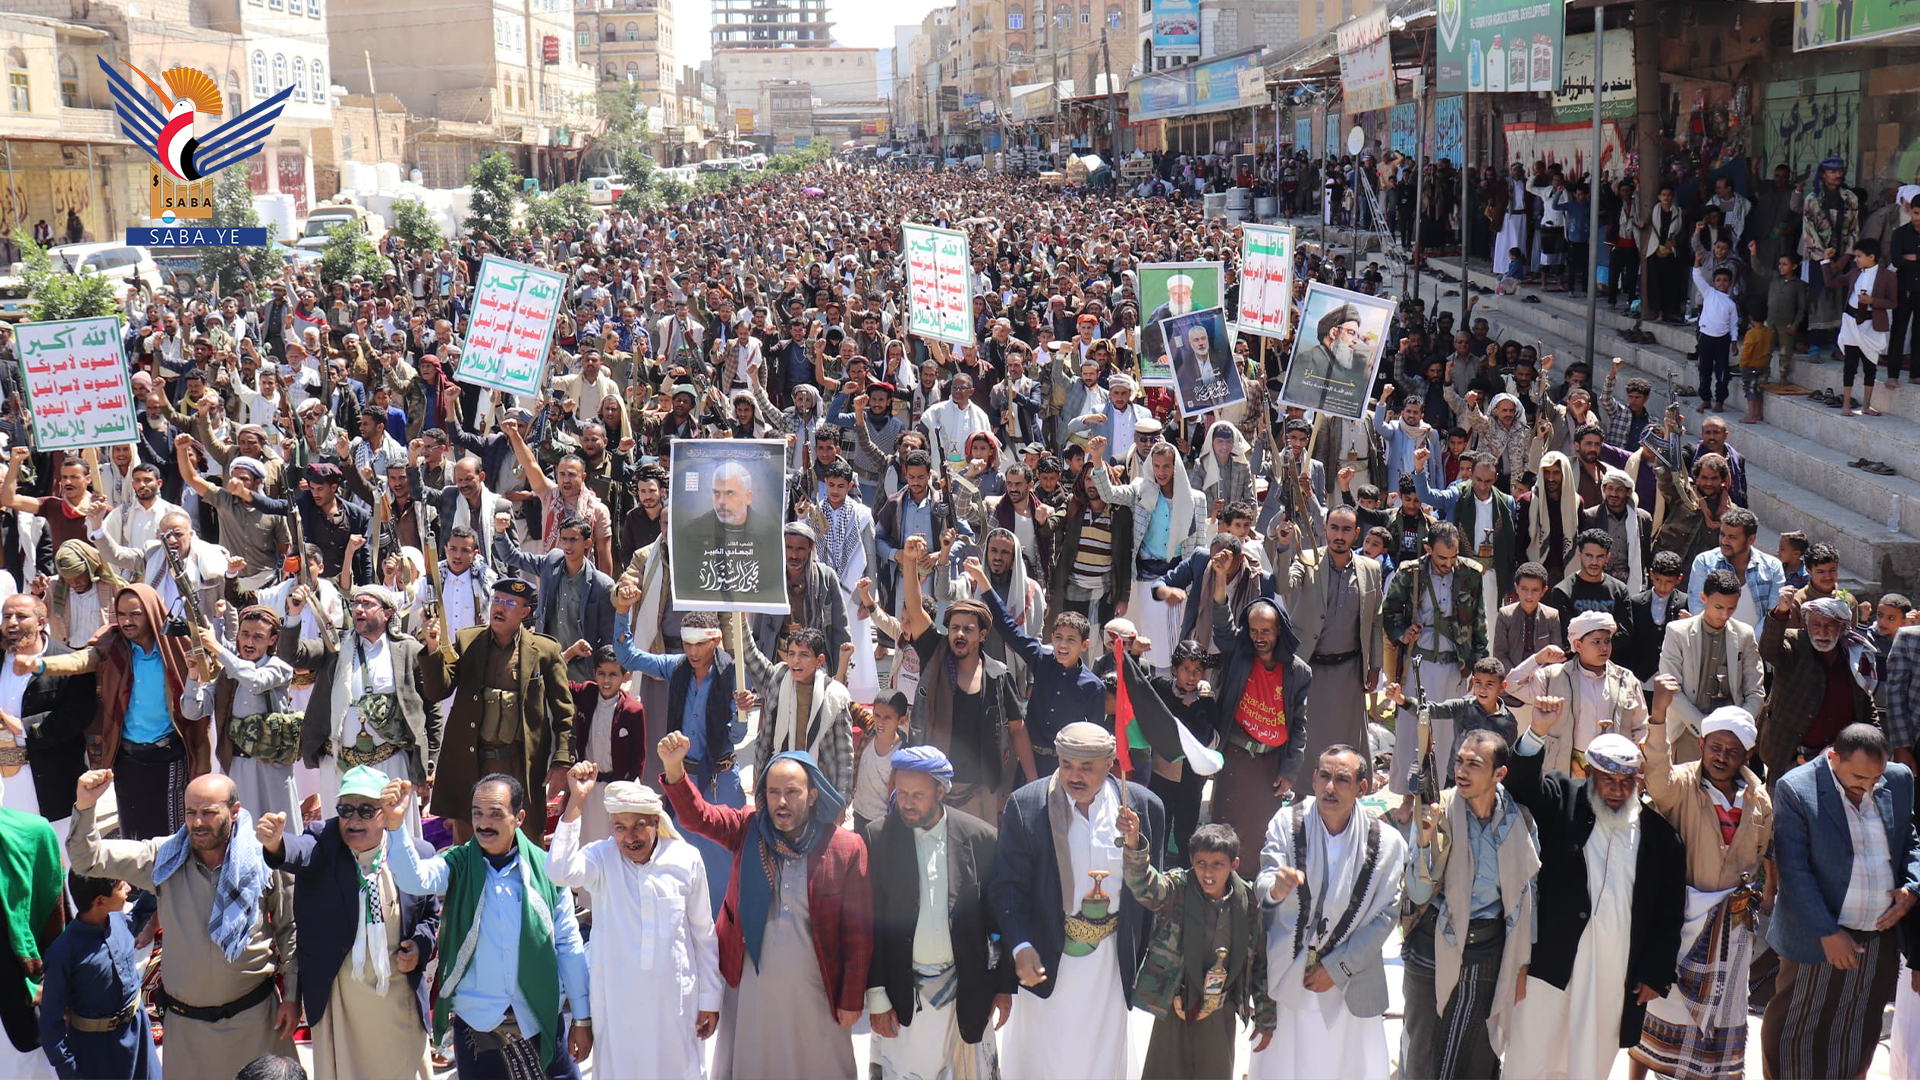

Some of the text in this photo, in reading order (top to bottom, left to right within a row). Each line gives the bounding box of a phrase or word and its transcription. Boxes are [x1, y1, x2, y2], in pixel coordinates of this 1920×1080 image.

[1520, 3, 1550, 20] DEVELOPMENT
[1590, 76, 1632, 94] للخدمت
[528, 278, 557, 300] الله
[518, 304, 551, 321] الموت
[25, 325, 116, 357] الله أكبر
[514, 324, 546, 341] الموت
[468, 334, 541, 361] اللعنة على اليهود
[26, 352, 120, 375] الموت لأمريكا
[462, 351, 537, 381] النصر للإسلام
[32, 374, 123, 398] الموت لإسرائيل
[35, 394, 127, 418] اللعنة على اليهود
[40, 413, 131, 443] النصر للإسلام
[704, 548, 724, 556] الكبير
[1573, 600, 1615, 612] GHOST
[1239, 700, 1277, 727] Chartered
[1243, 693, 1277, 715] Standard
[1257, 730, 1280, 740] الراعي
